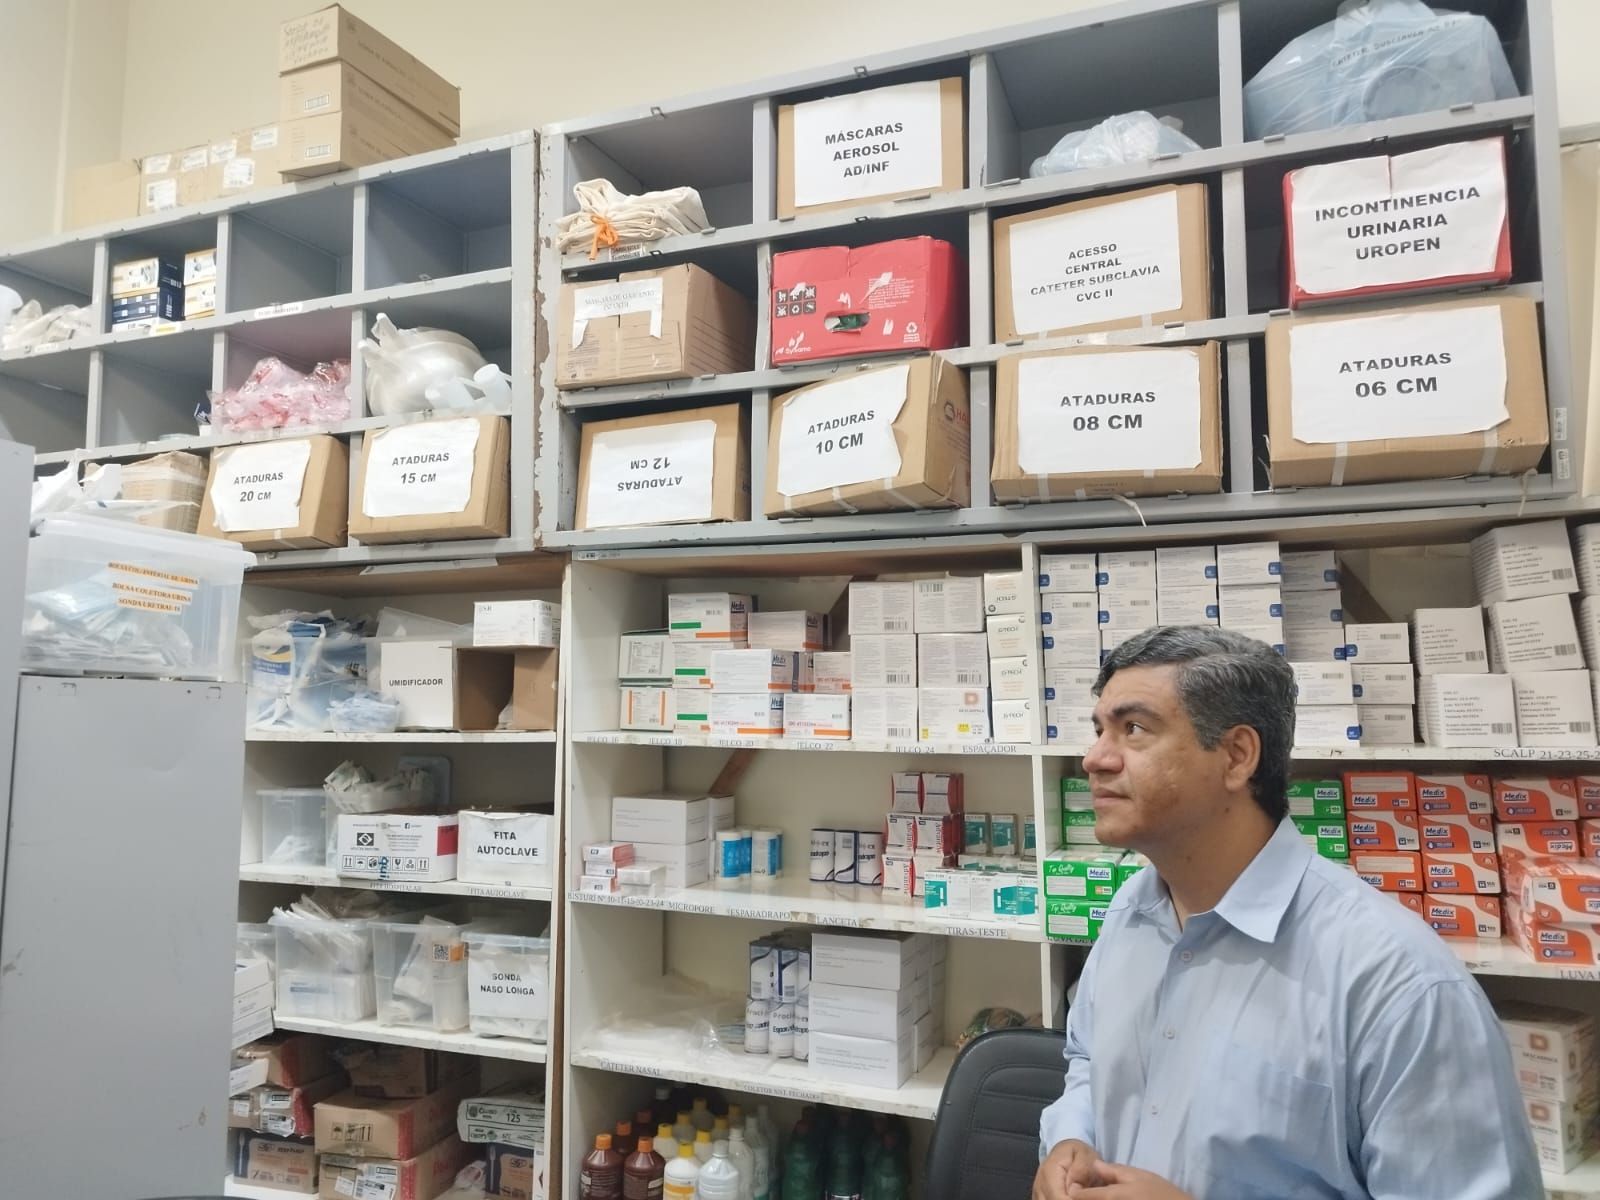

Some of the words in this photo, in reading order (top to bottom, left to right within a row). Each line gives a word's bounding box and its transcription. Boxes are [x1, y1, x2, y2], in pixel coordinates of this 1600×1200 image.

[825, 122, 903, 145] MÁSCARAS
[833, 141, 900, 162] AEROSOL
[843, 160, 890, 178] AD/INF
[1315, 186, 1480, 222] INCONTINENCIA
[1347, 213, 1448, 239] URINARIA
[1068, 243, 1117, 260] ACESSO
[1356, 237, 1440, 260] UROPEN
[1065, 257, 1122, 275] CENTRAL
[1030, 279, 1085, 296] CATETER
[1089, 265, 1160, 285] SUBCLAVIA
[1076, 290, 1101, 302] CVC
[1105, 288, 1113, 297] II
[1339, 352, 1452, 374] ATADURAS
[1355, 381, 1386, 398] 06
[1397, 376, 1438, 394] CM
[1060, 391, 1156, 407] ATADURAS
[807, 410, 875, 435] ATADURAS
[1073, 416, 1099, 431] 08
[1107, 414, 1143, 430] CM
[815, 439, 834, 455] 10
[838, 432, 864, 450] CM
[391, 452, 450, 467] ATADURAS
[630, 459, 648, 470] CM
[653, 457, 671, 470] 12
[233, 472, 284, 486] ATADURAS
[400, 472, 416, 484] 15
[420, 473, 436, 483] CM
[617, 475, 683, 492] ATADURAS
[239, 491, 254, 502] 20
[257, 491, 272, 501] CM
[388, 677, 444, 687] UMIDIFICADOR
[962, 744, 1017, 755] ESPAÇADOR
[1494, 748, 1535, 758] SCALP
[494, 831, 517, 841] FITA
[1425, 828, 1448, 836] Medix
[477, 846, 539, 857] AUTOCLAVE
[668, 902, 714, 914] MICROPORE
[730, 909, 791, 921] ESPARADRAPO
[816, 916, 858, 927] LANCETA
[946, 926, 1007, 937] TIRAS-TESTE
[1540, 932, 1566, 940] Medix
[492, 972, 522, 982] SONDA
[1560, 970, 1595, 980] LUVA
[480, 985, 503, 994] NASO
[506, 985, 535, 996] LONGA
[506, 1113, 521, 1123] 125
